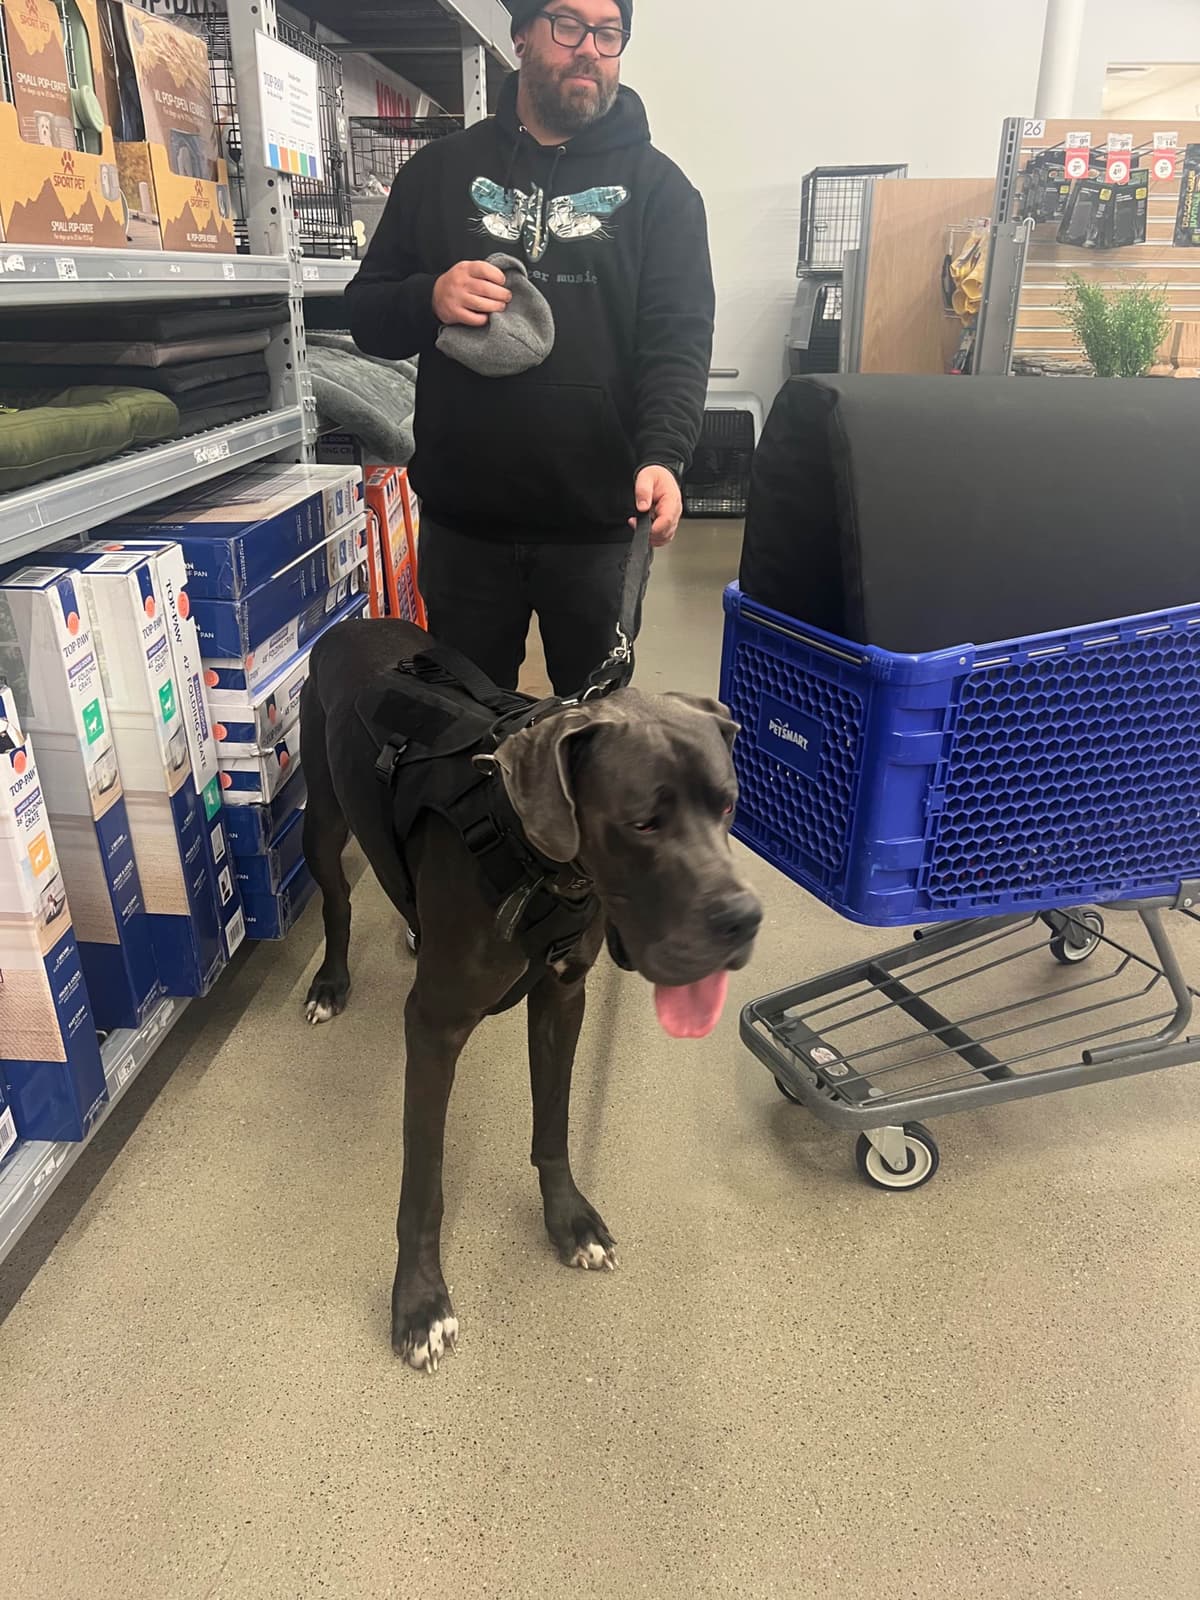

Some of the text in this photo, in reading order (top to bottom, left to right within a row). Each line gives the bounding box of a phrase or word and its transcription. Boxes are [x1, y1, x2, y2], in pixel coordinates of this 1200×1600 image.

[20, 14, 50, 32] SPORT PET
[16, 72, 37, 87] SMALL
[37, 77, 68, 94] POP-CRATE
[1024, 122, 1042, 136] 26
[53, 175, 86, 190] SPORT PET
[51, 221, 94, 234] SMALL POP-CRATE
[529, 270, 598, 284] er music
[78, 663, 97, 681] FOLDING
[78, 676, 92, 692] CRATE
[187, 676, 200, 731] FOLDING
[196, 733, 207, 770] CRATE
[768, 719, 808, 752] PETSMART
[24, 797, 43, 819] FOLDING
[25, 810, 40, 828] CRATE
